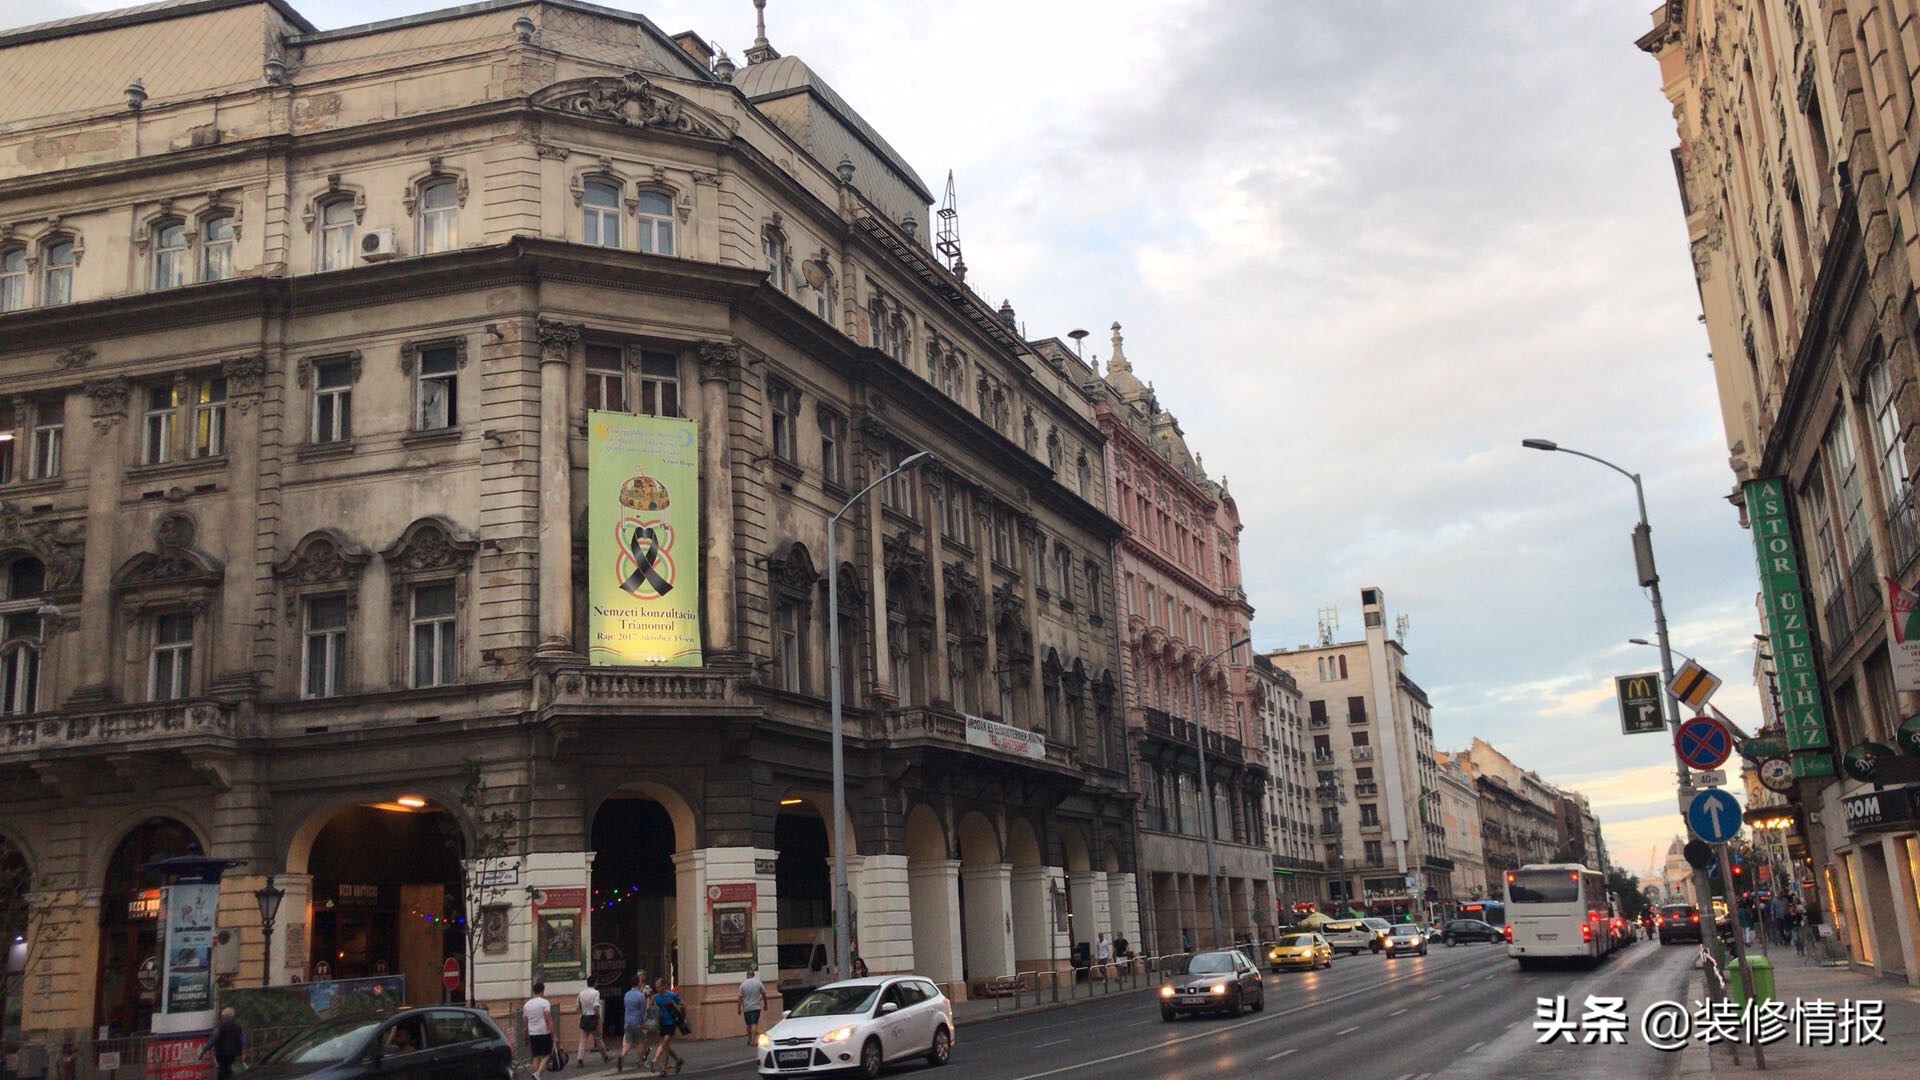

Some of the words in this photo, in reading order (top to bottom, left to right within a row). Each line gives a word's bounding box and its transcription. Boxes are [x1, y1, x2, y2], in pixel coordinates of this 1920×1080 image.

[593, 606, 638, 617] Nemzeti
[1761, 483, 1791, 573] ASTOR
[1780, 592, 1821, 745] ÜZLETHÁZ
[1701, 775, 1711, 784] 40
